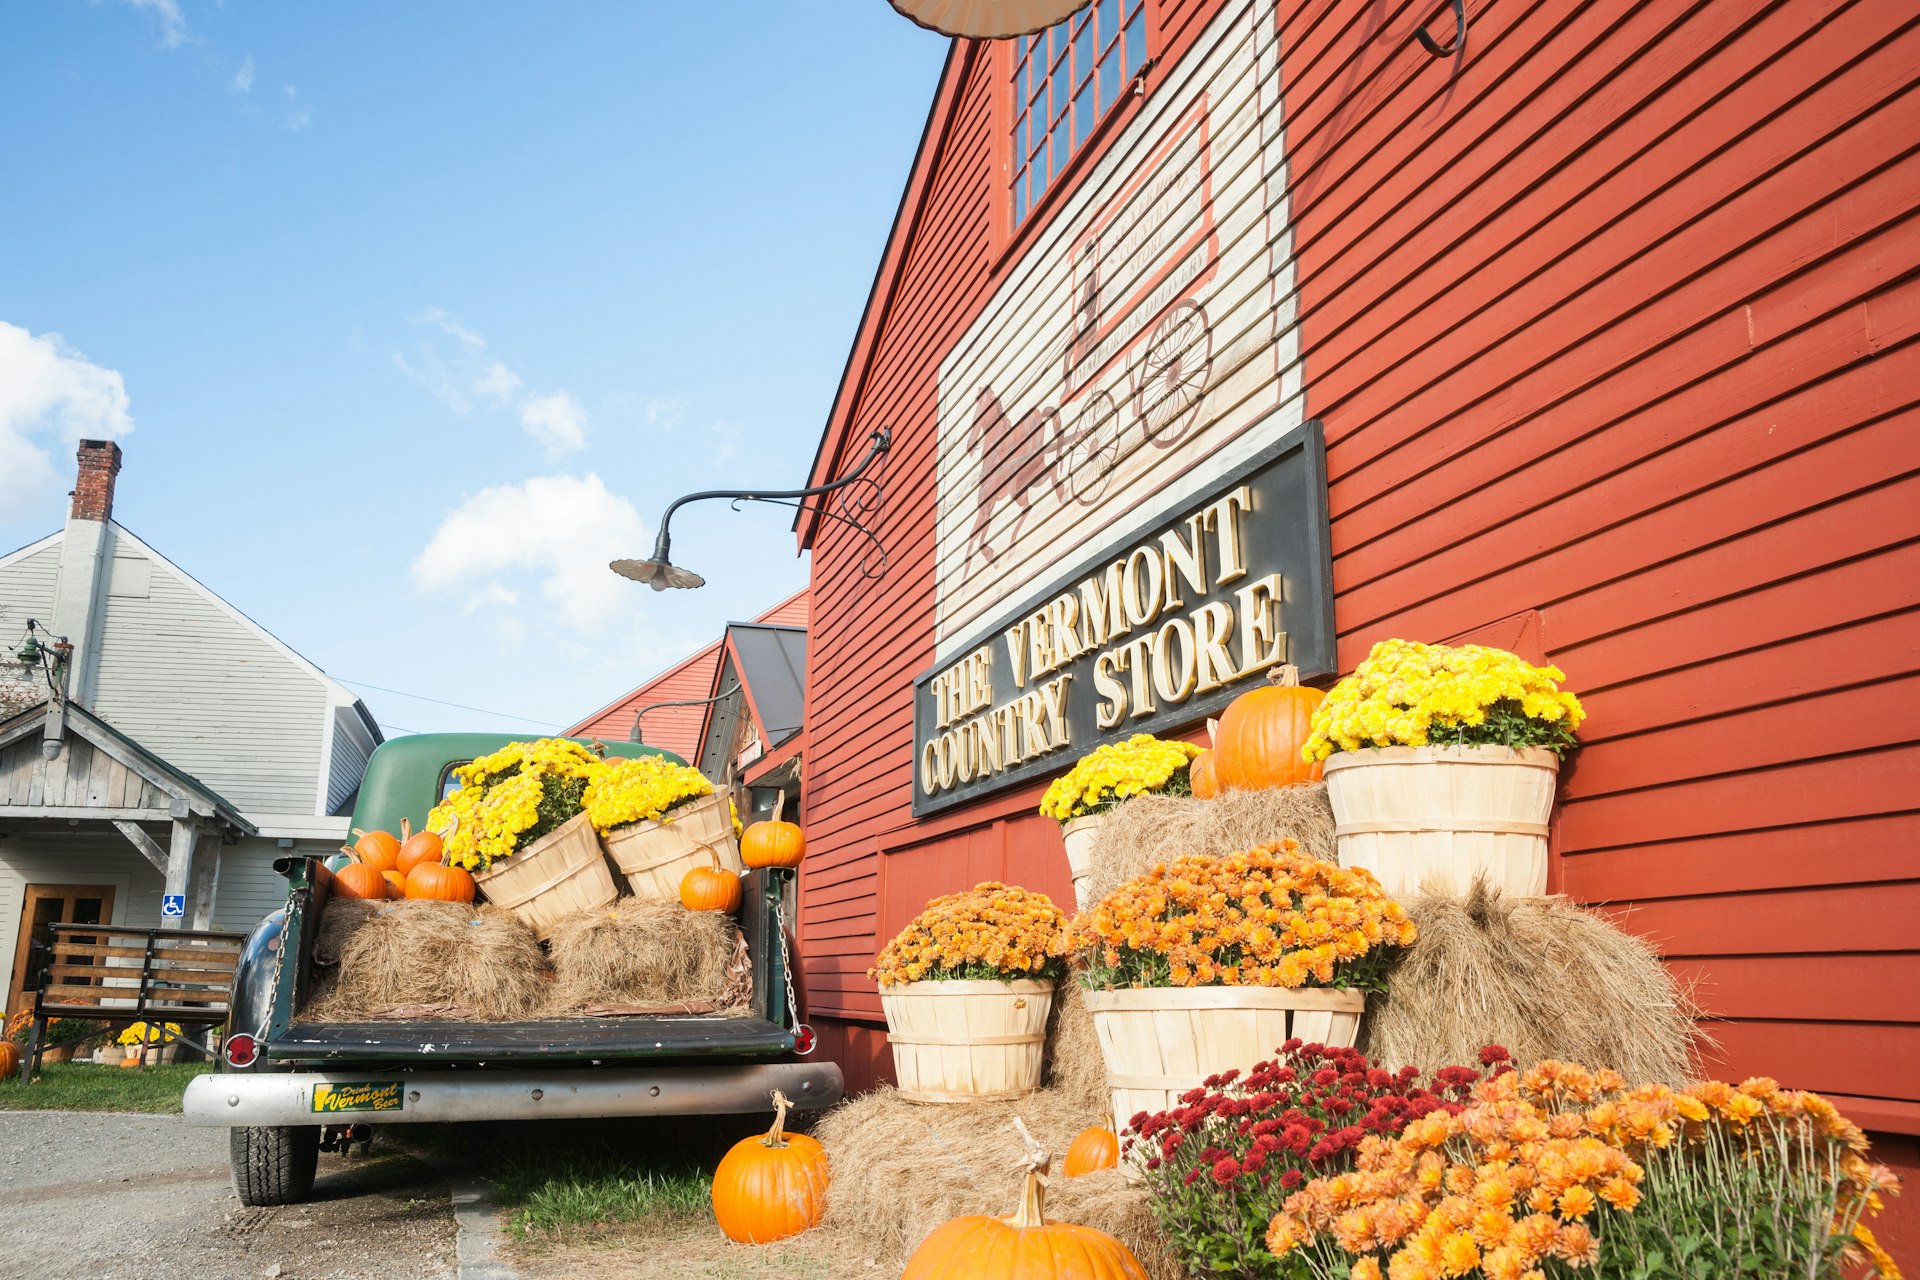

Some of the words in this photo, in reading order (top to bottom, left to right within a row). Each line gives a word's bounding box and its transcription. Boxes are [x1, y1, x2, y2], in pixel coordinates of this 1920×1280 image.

[1129, 231, 1164, 276] STORE
[1104, 317, 1142, 359] ORDER
[1144, 252, 1205, 319] DELIVERY
[931, 645, 993, 730] THE
[1003, 485, 1252, 688] VERMONT
[921, 672, 1074, 796] COUNTRY
[1093, 573, 1288, 730] STORE
[325, 1082, 398, 1111] Vermont
[341, 1082, 372, 1097] Drink
[373, 1097, 399, 1110] Beer
